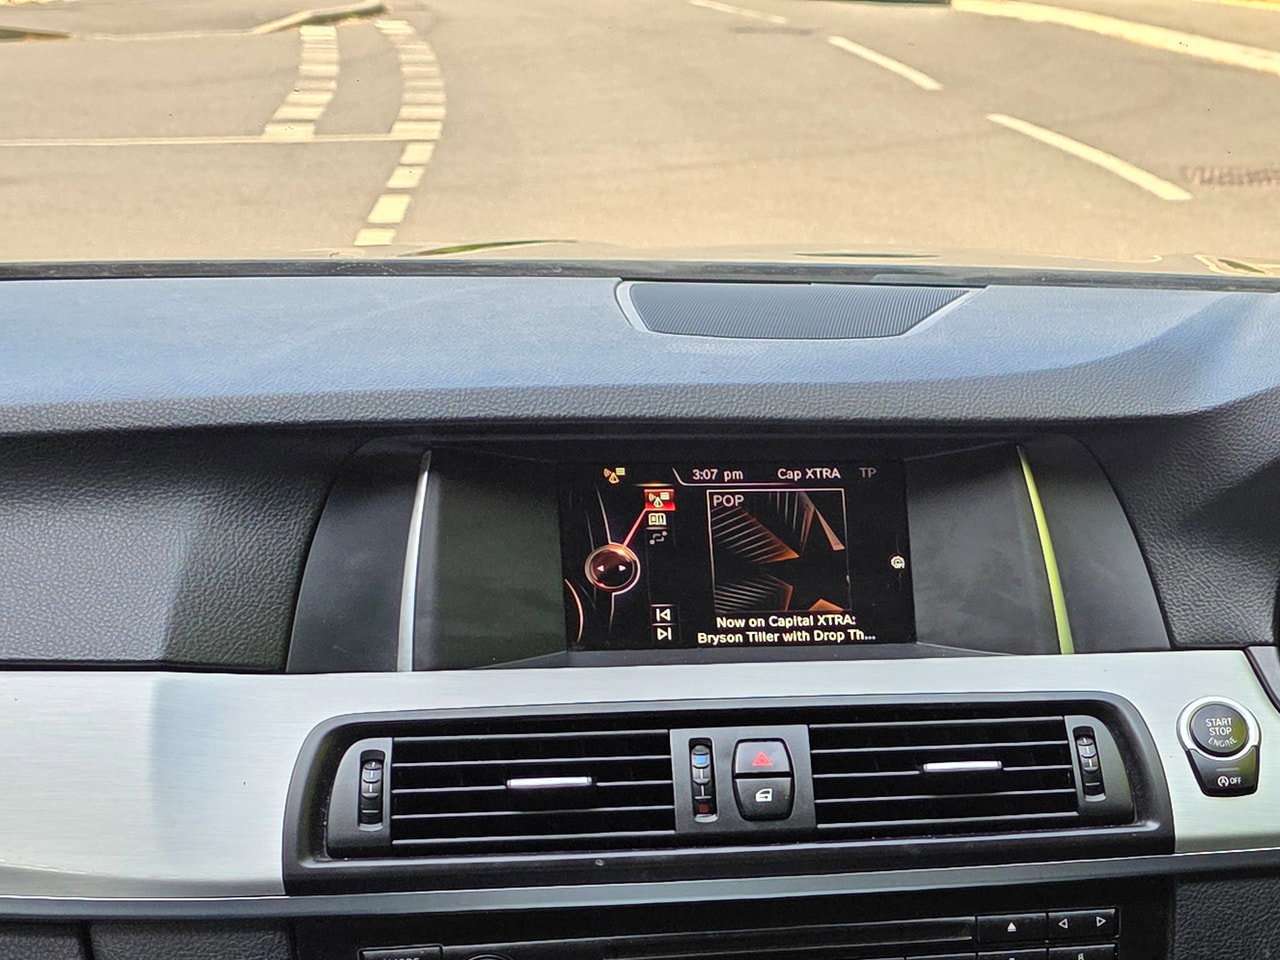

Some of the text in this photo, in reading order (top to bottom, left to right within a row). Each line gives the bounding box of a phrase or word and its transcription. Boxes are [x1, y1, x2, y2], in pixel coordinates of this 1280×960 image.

[692, 468, 744, 482] 3:07 pm
[777, 467, 841, 482] Cap XTRA
[859, 467, 877, 478] TP
[713, 494, 744, 507] POP
[716, 614, 856, 629] Now on Capital XTRA:
[697, 631, 743, 646] Bryson
[746, 631, 780, 643] Tiller
[783, 630, 811, 642] with
[813, 629, 845, 643] Drop
[1205, 717, 1232, 728] START
[1209, 726, 1232, 736] STOP
[1229, 776, 1242, 785] OFF
